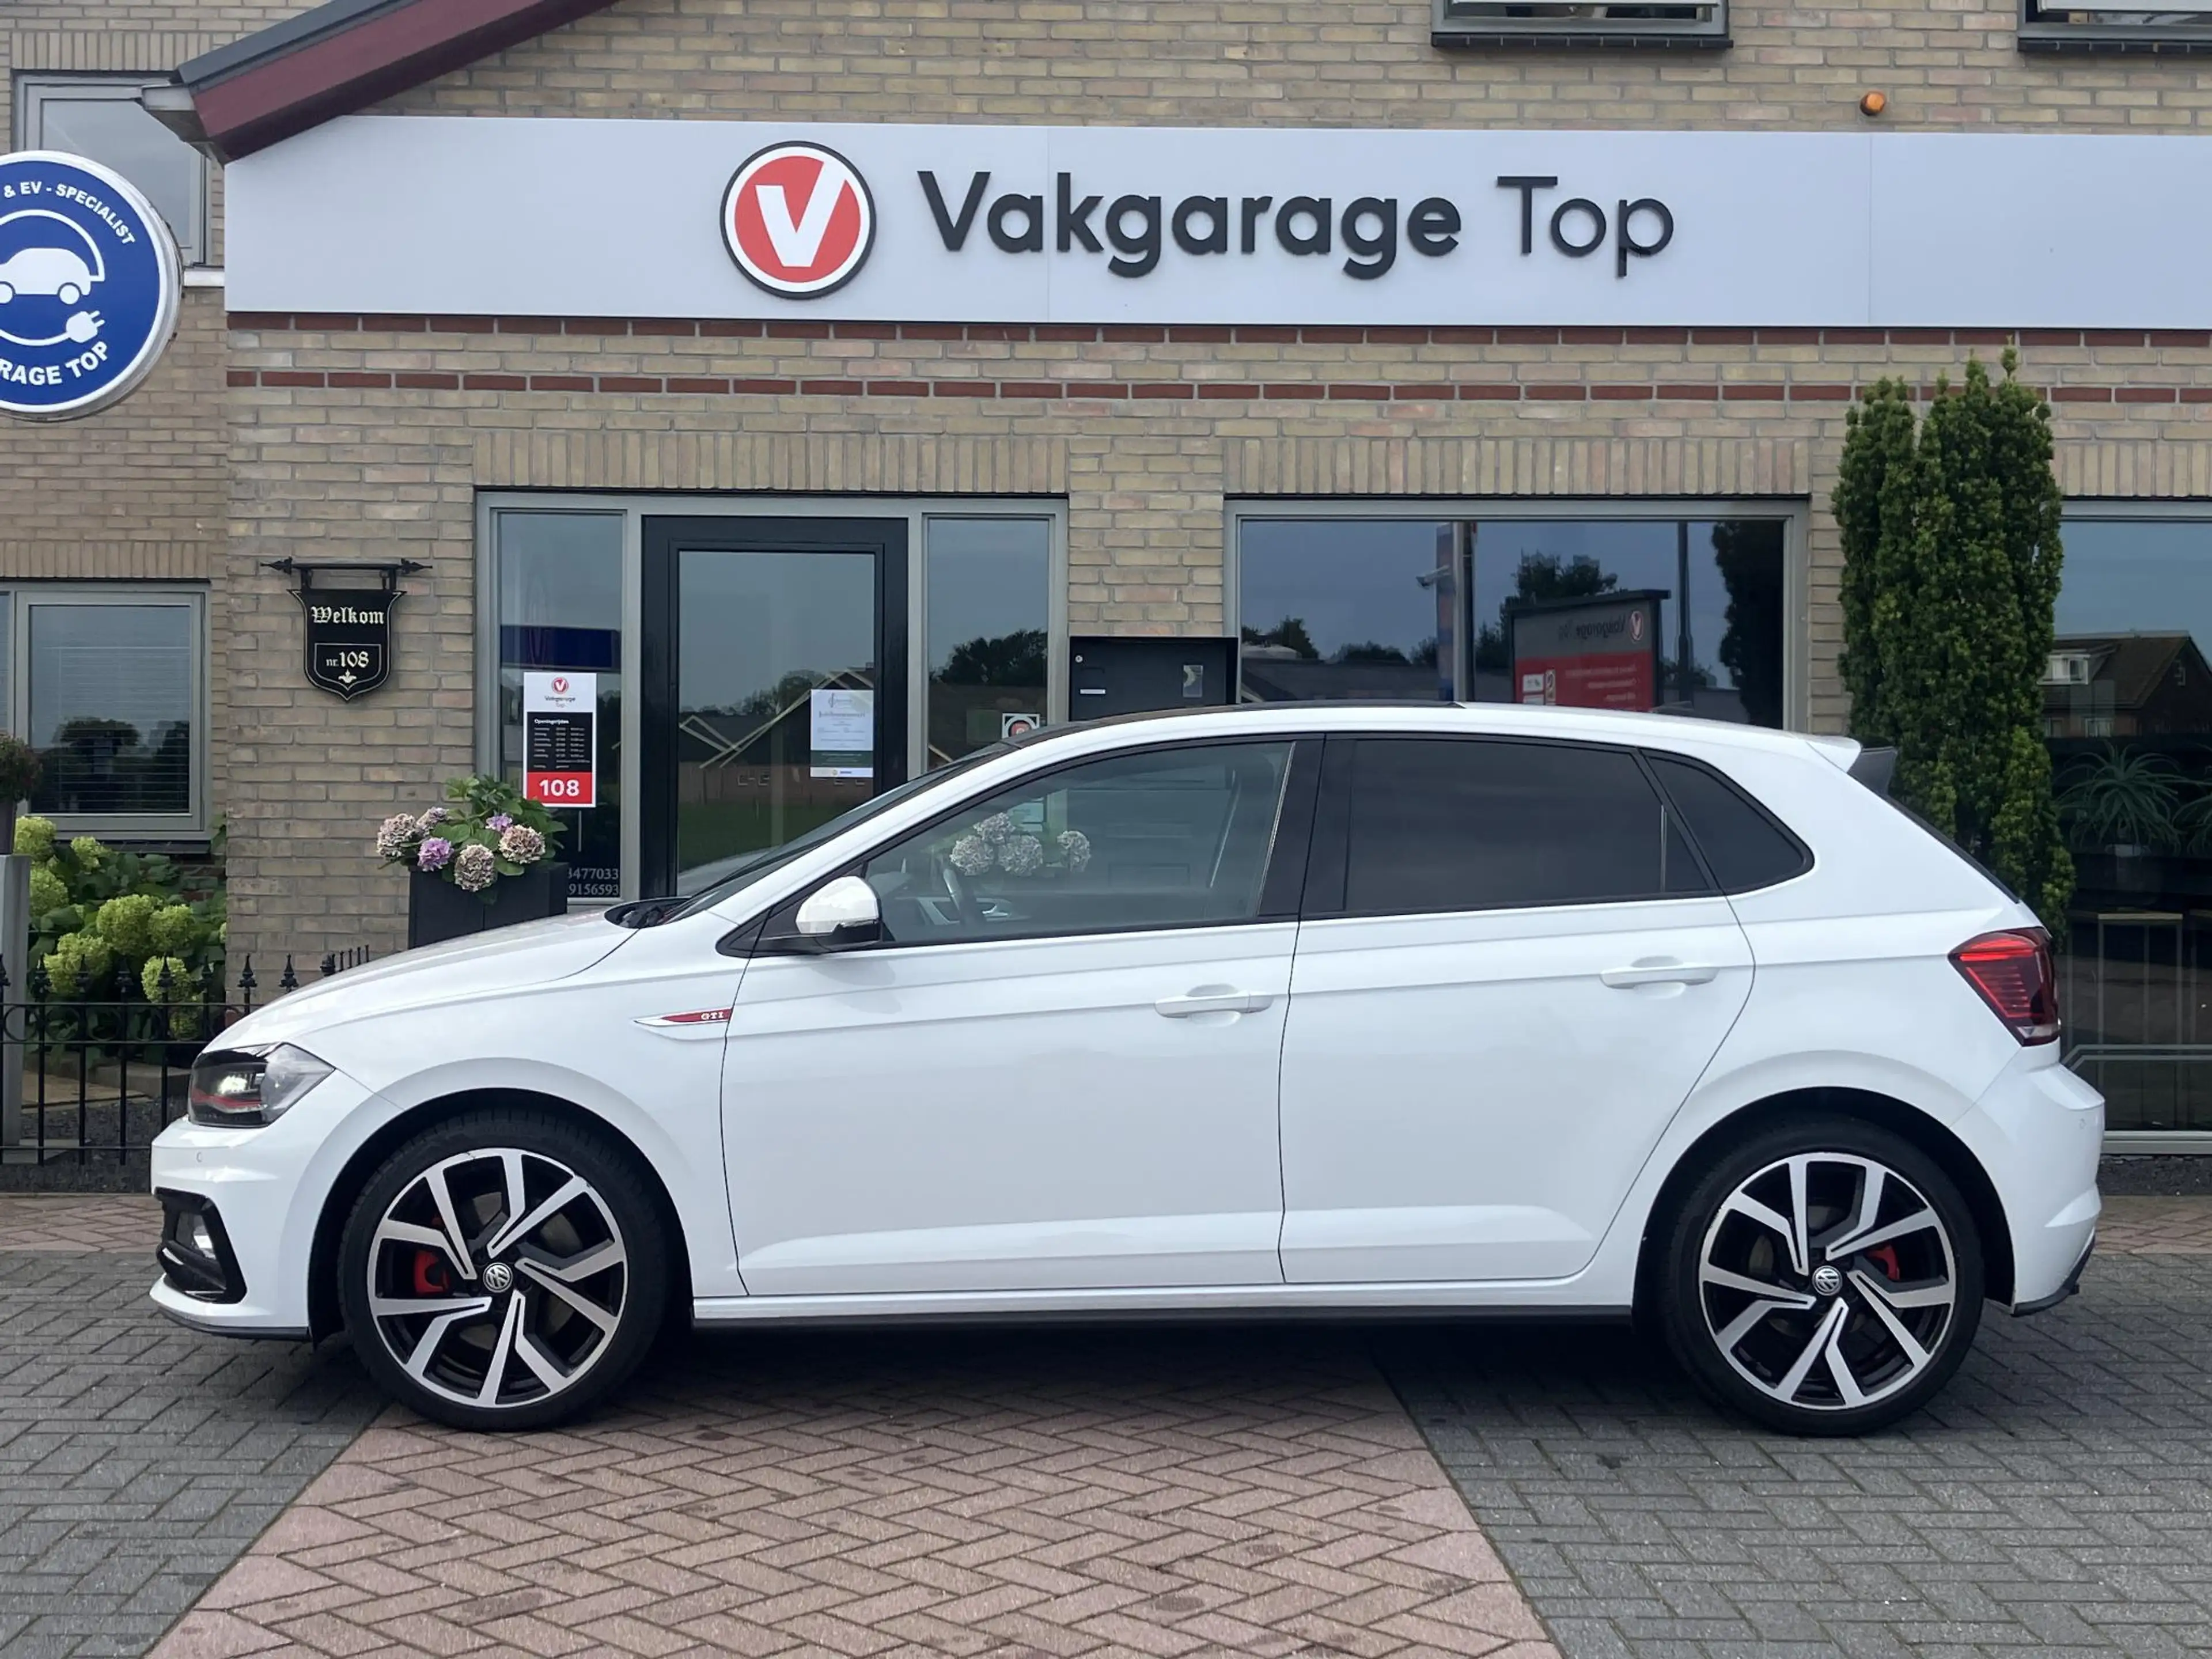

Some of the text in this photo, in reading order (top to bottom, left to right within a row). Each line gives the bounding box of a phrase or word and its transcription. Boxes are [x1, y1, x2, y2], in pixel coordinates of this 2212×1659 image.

[3, 185, 16, 198] &
[20, 181, 41, 195] EV
[55, 183, 135, 244] SPECIALIST
[916, 171, 1674, 280] Vakgarage Top
[65, 341, 108, 378] TOP
[310, 607, 385, 624] Welkom
[539, 779, 579, 797] 108
[569, 884, 619, 895] 9156593
[701, 1012, 725, 1020] GTI
